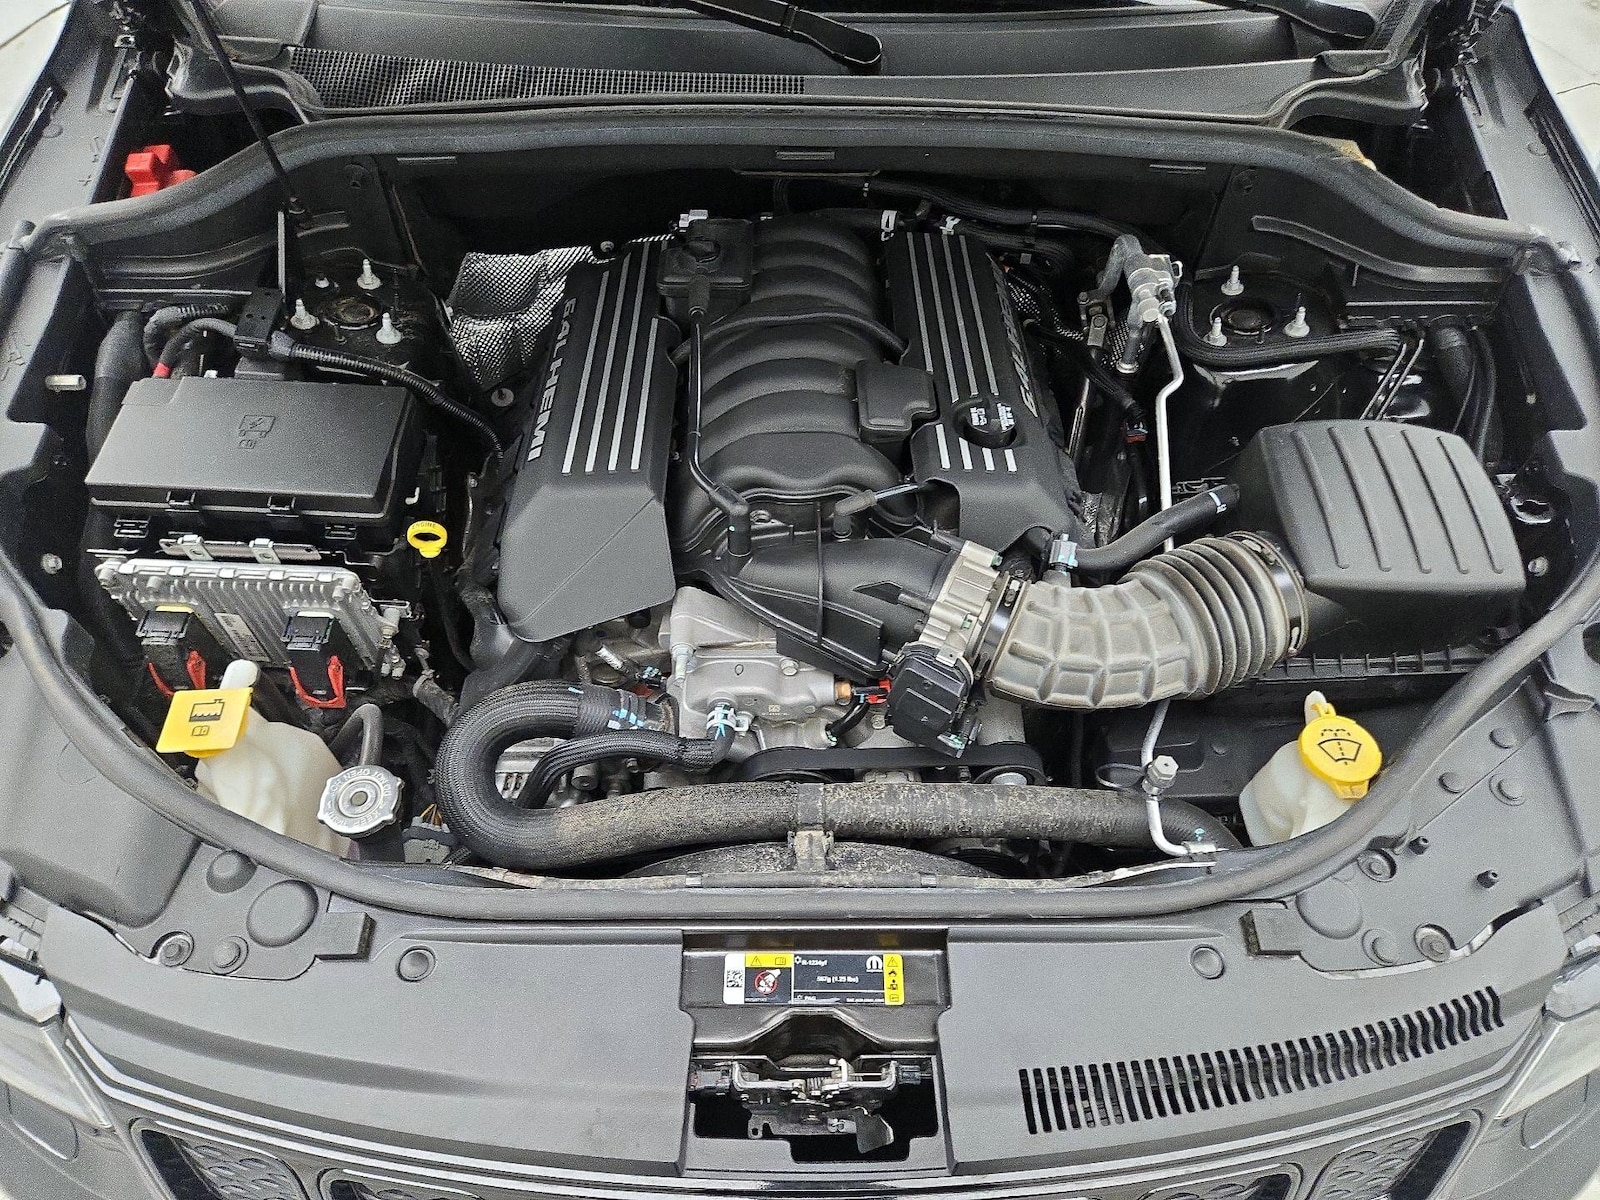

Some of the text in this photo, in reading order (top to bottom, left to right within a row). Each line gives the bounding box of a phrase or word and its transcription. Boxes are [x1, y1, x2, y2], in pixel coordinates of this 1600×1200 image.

[527, 357, 564, 462] HEMI
[411, 521, 436, 529] ENGINE
[343, 768, 371, 781] OPEN
[371, 770, 388, 785] NOT
[801, 959, 828, 967] R-1234yf
